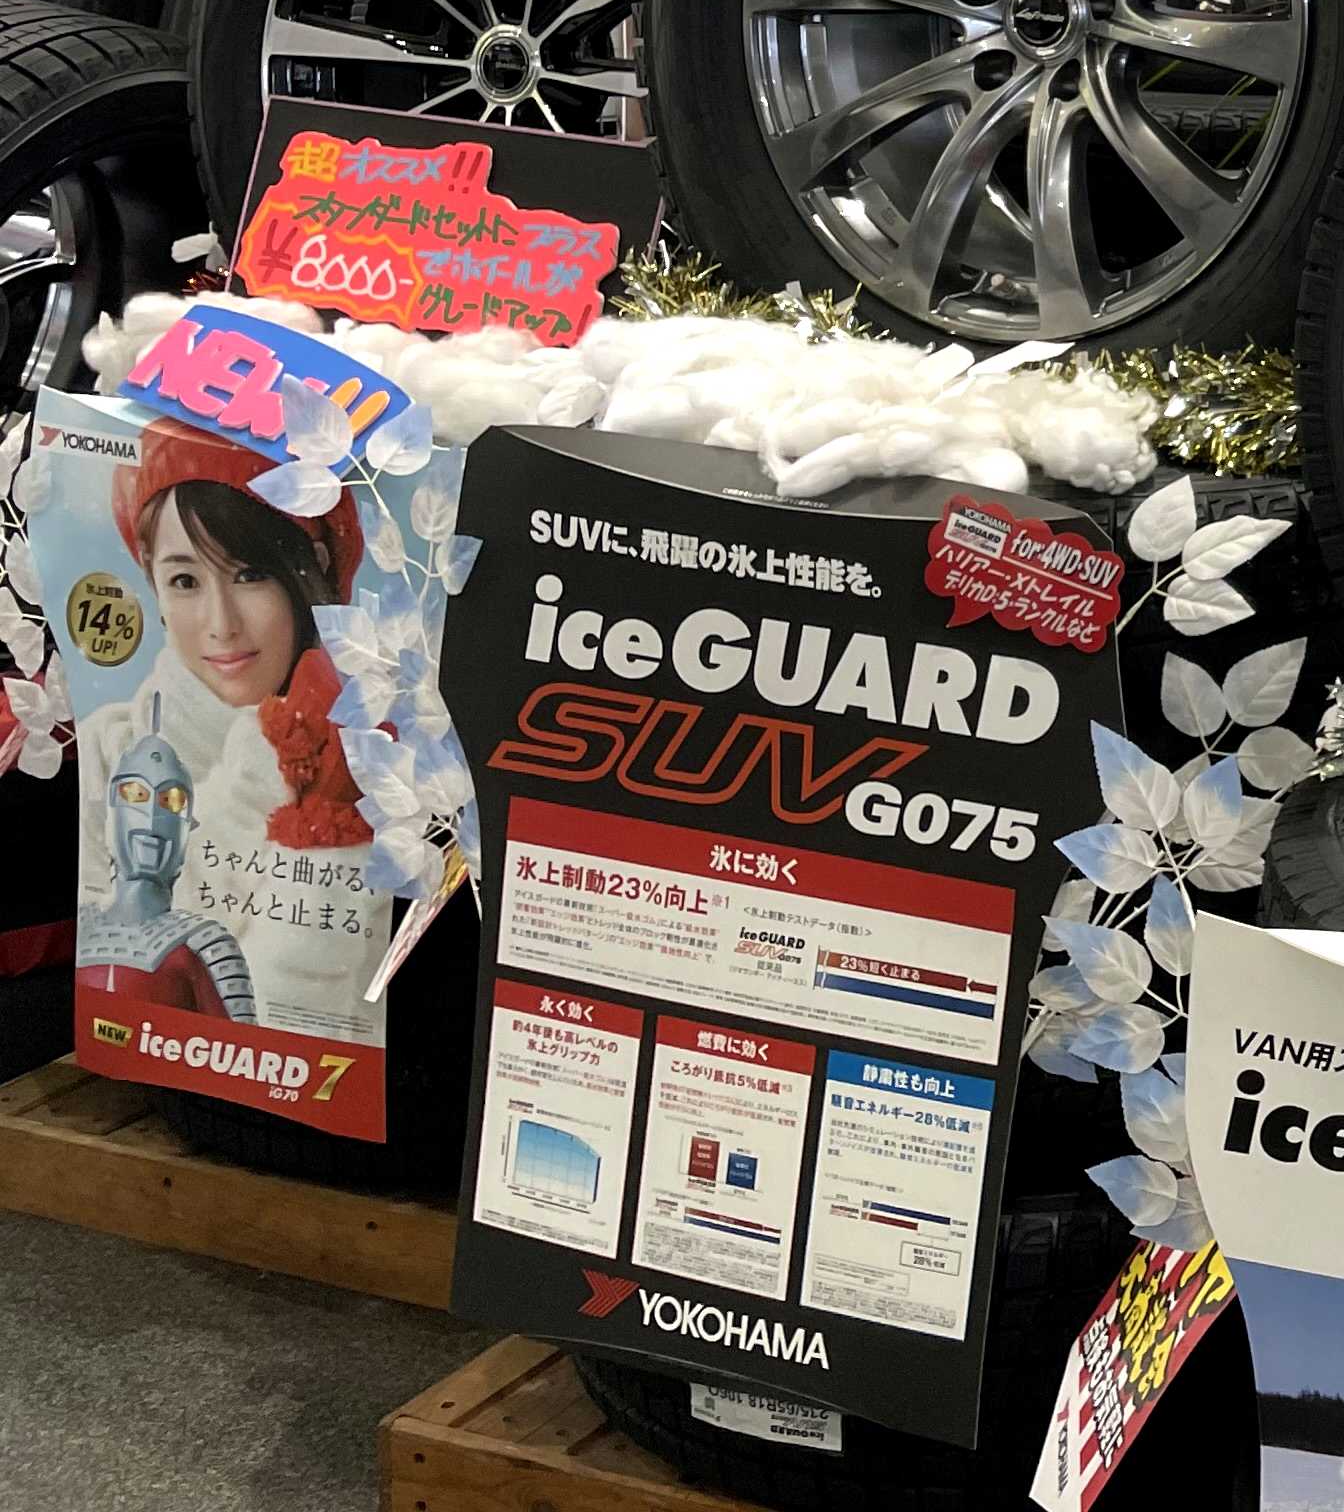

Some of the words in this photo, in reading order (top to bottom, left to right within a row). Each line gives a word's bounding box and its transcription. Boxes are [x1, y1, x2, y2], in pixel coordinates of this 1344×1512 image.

[60, 430, 137, 460] YOKOHAMA
[530, 508, 883, 600] SUVに、飛躍の氷上性能を。
[76, 598, 134, 642] 14%
[91, 637, 119, 656] UP!
[523, 573, 1060, 746] iceGUARD
[485, 681, 931, 826] SUV
[844, 781, 1040, 864] G075
[202, 839, 376, 896] ちゃんと曲がる、
[516, 855, 709, 916] 氷上制動23%向上
[709, 843, 799, 886] 氷に効く
[199, 880, 373, 940] ちゃんと止まる。
[96, 1022, 129, 1044] NEW
[138, 1022, 310, 1089] iceGUARD
[312, 1054, 357, 1101] 7
[268, 1085, 299, 1103] iG70
[638, 1287, 831, 1370] YOKOHAMA
